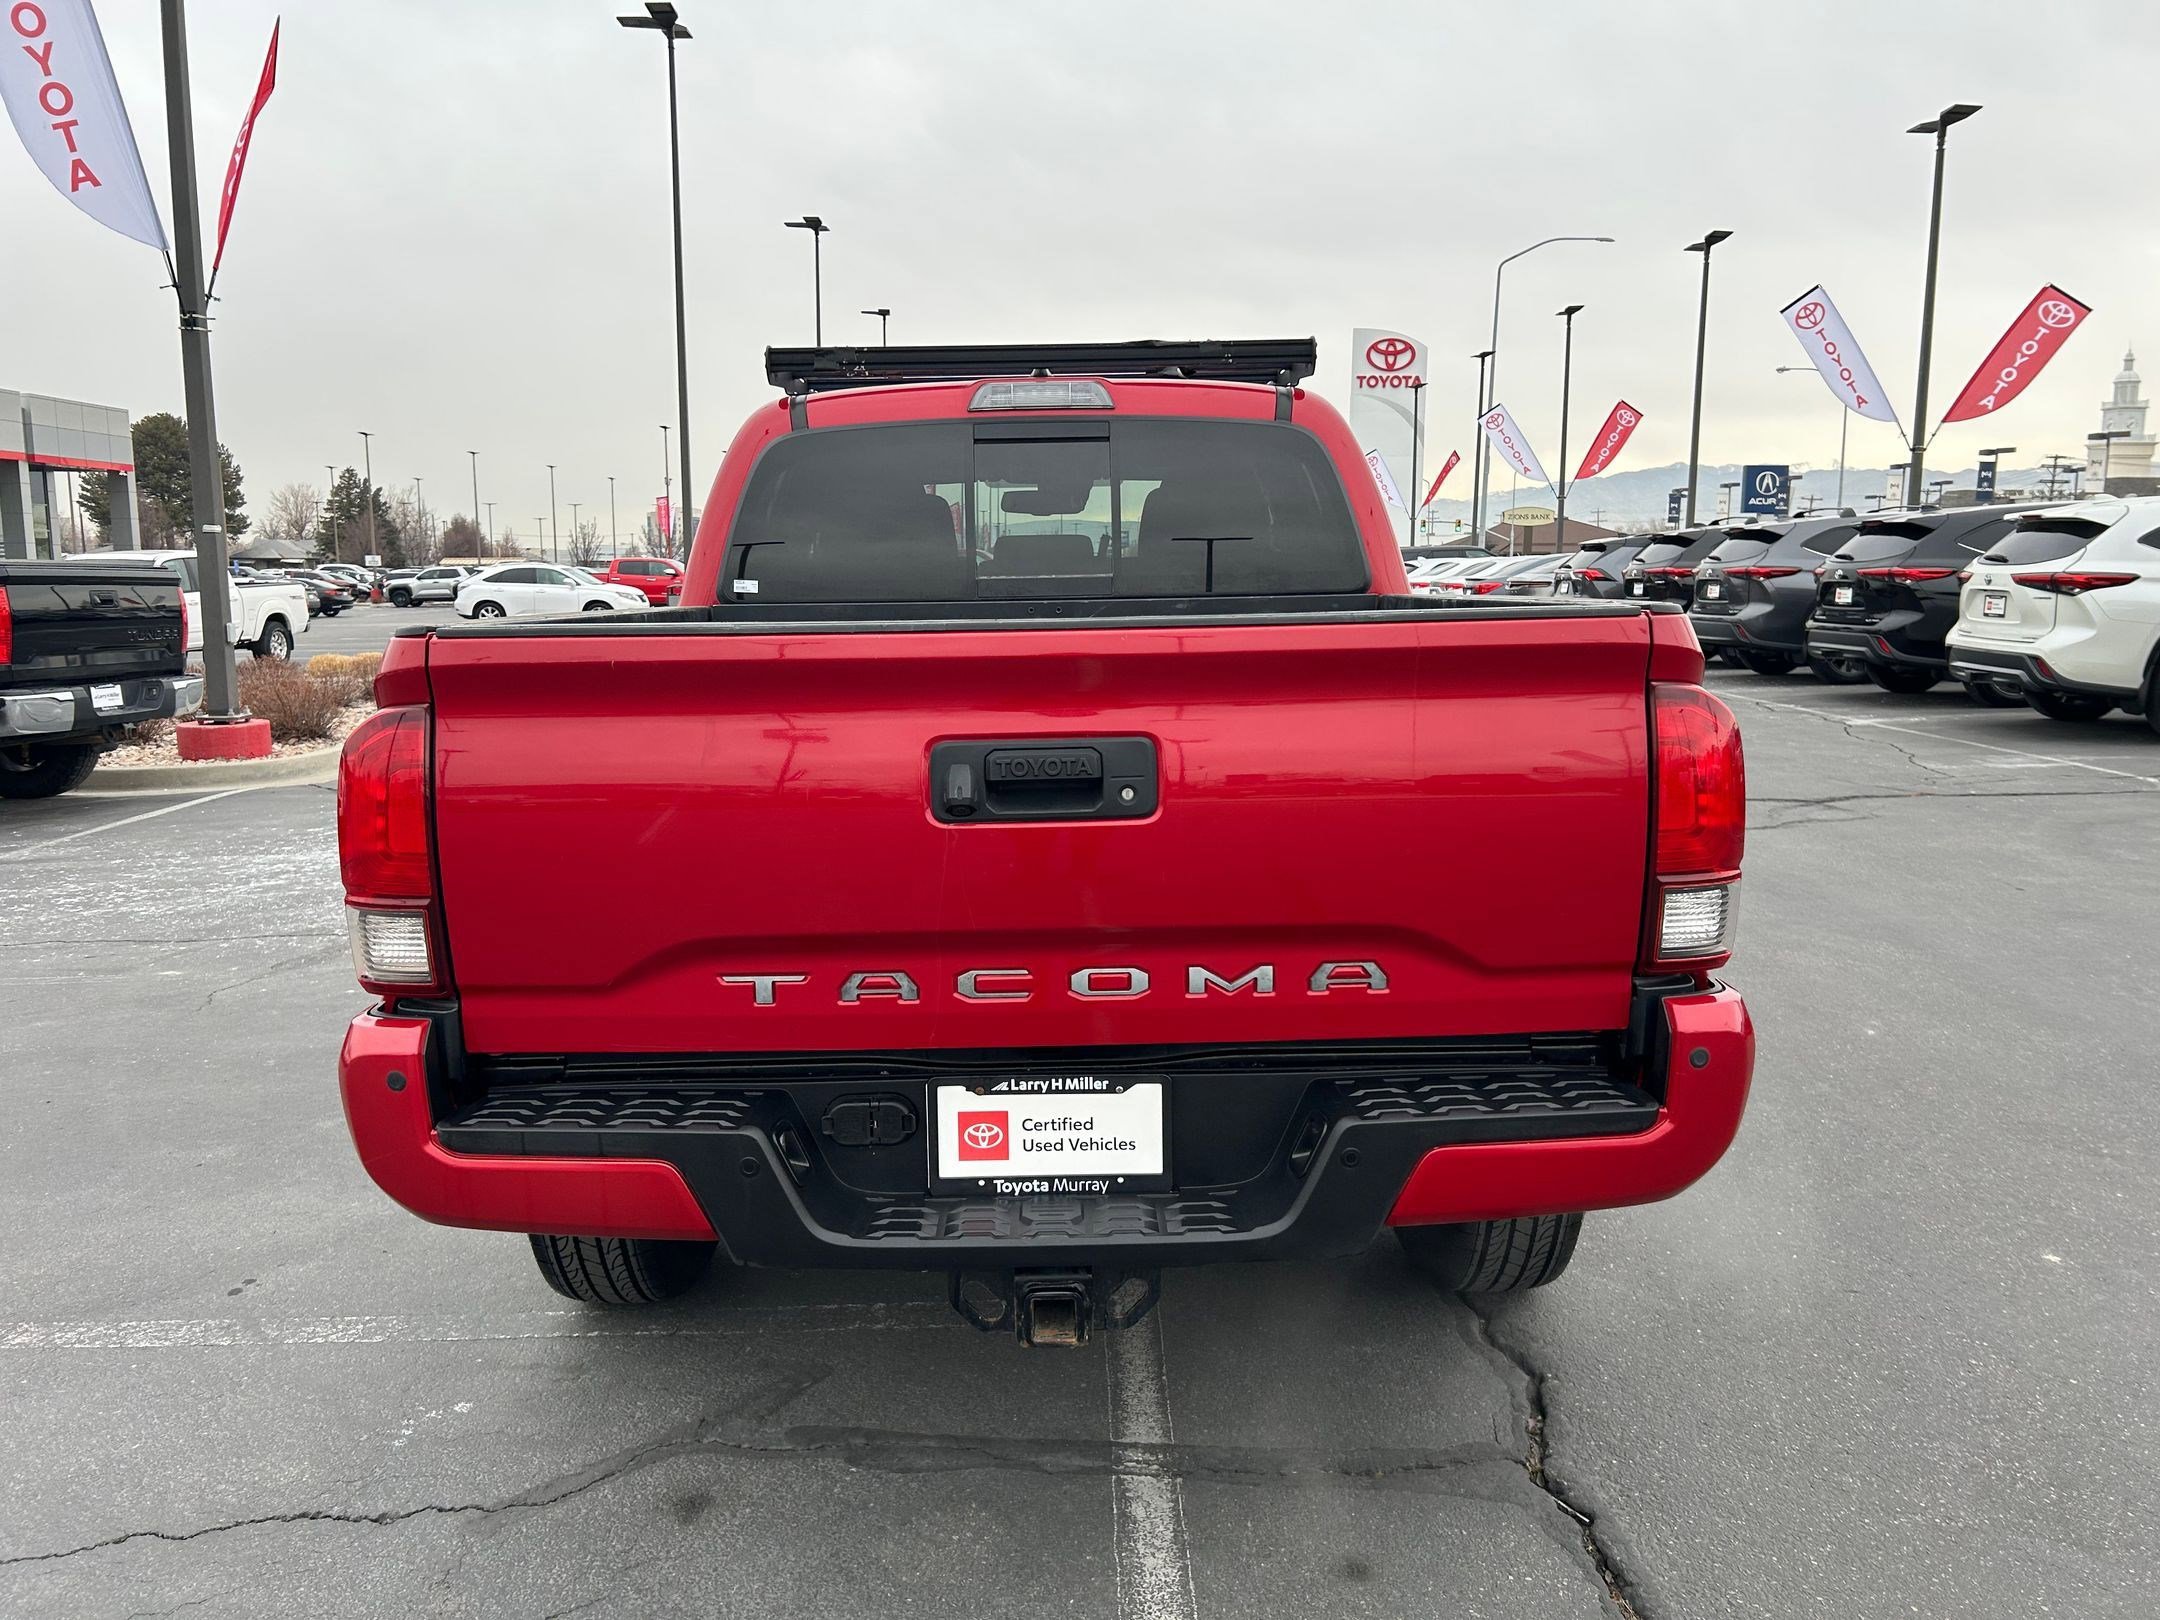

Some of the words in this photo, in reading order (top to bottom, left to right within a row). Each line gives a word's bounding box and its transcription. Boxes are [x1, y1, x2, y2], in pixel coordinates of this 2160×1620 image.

[10, 1, 102, 193] OYOTA
[1356, 375, 1422, 388] TOYOTA
[1815, 327, 1869, 409] TOYOTA
[1978, 326, 2050, 410] TOYOTA
[1498, 428, 1532, 475] TOYOTA
[1590, 424, 1624, 472] TOYOTA
[1373, 467, 1394, 502] TOYOTA
[1748, 497, 1777, 505] ACUR
[996, 757, 1093, 778] TOYOTA
[717, 960, 1391, 1006] TACOMA
[1010, 1078, 1049, 1094] Larry
[1051, 1079, 1063, 1091] H
[1065, 1077, 1109, 1091] Miller
[1022, 1117, 1094, 1132] Certified
[1023, 1138, 1064, 1152] Used
[1068, 1137, 1136, 1151] Vehicles
[993, 1179, 1049, 1194] Toyota
[1052, 1178, 1109, 1194] Murray
